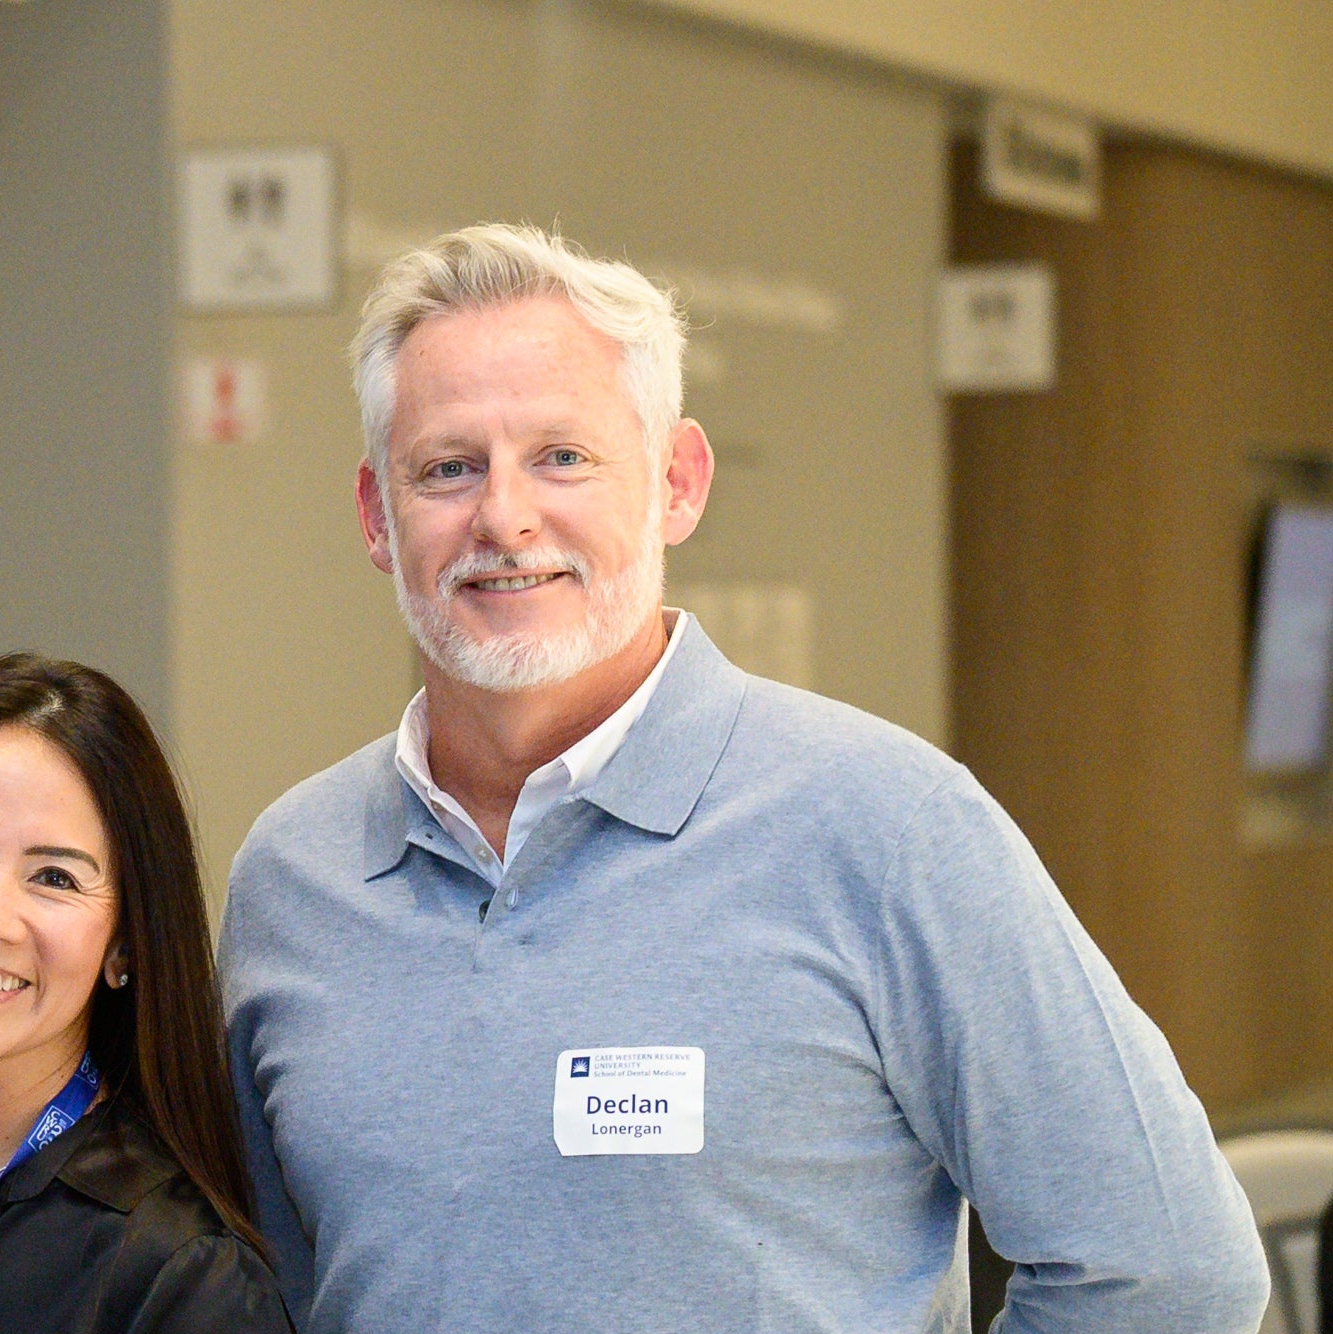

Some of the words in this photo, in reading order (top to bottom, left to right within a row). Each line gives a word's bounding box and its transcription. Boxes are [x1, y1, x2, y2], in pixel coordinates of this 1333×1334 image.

[595, 1062, 641, 1070] UNIVERSITY
[594, 1070, 616, 1078] School
[587, 1094, 668, 1114] Declan
[591, 1123, 661, 1138] Lonergan
